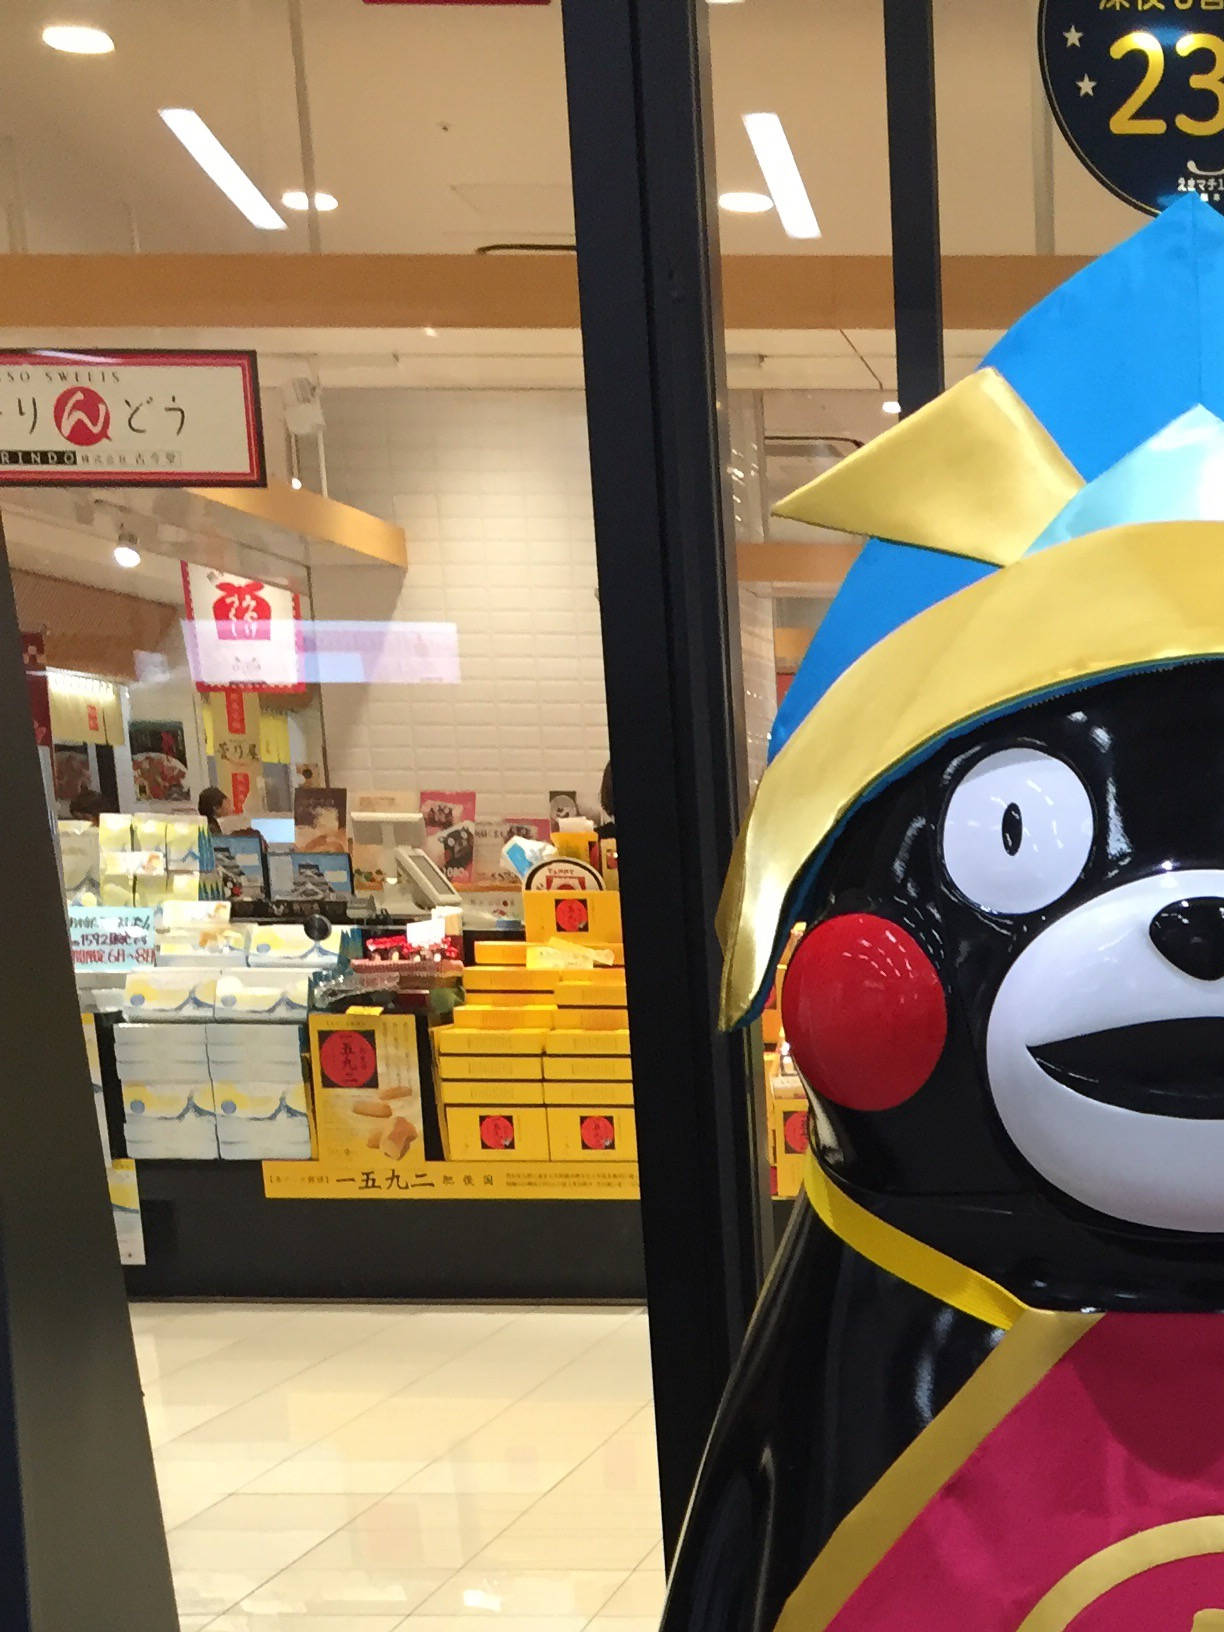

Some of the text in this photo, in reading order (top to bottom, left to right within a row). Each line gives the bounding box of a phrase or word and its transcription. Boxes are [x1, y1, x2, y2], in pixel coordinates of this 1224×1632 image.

[0, 372, 30, 383] SO
[0, 390, 186, 441] りんどう
[335, 1169, 435, 1190] 一五九二
